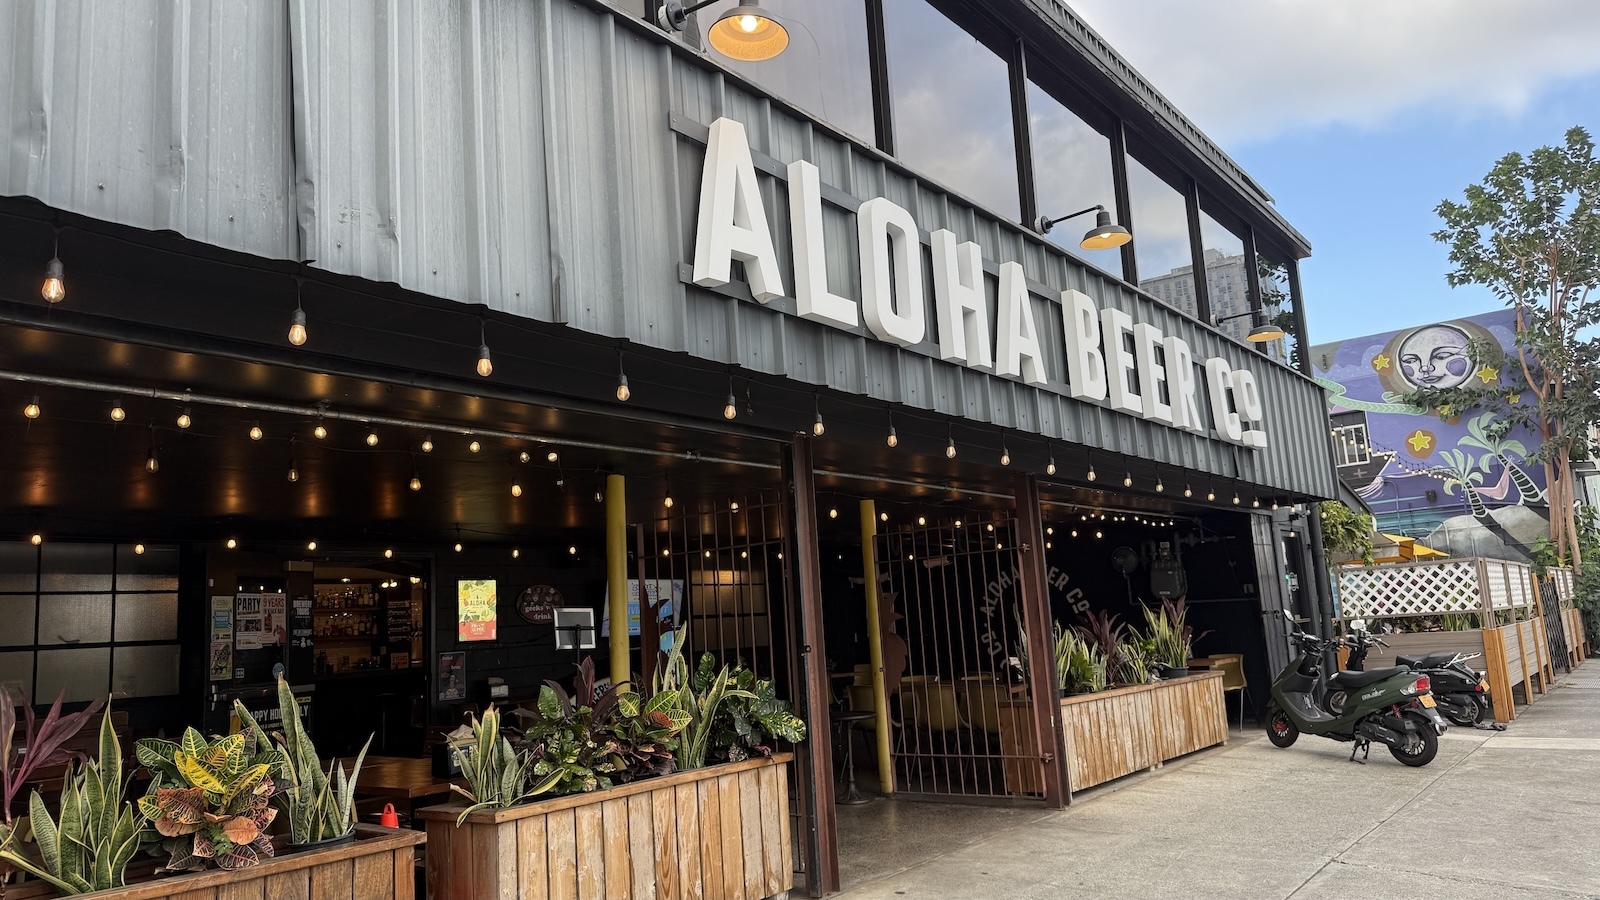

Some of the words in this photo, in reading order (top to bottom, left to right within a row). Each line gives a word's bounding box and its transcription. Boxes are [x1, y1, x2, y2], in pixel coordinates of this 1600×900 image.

[692, 116, 1048, 385] ALOHA
[1060, 288, 1203, 433] BEER
[980, 564, 1021, 617] ALOHA
[237, 597, 261, 611] PARTY
[268, 597, 285, 608] YEARS
[524, 605, 544, 614] geeks
